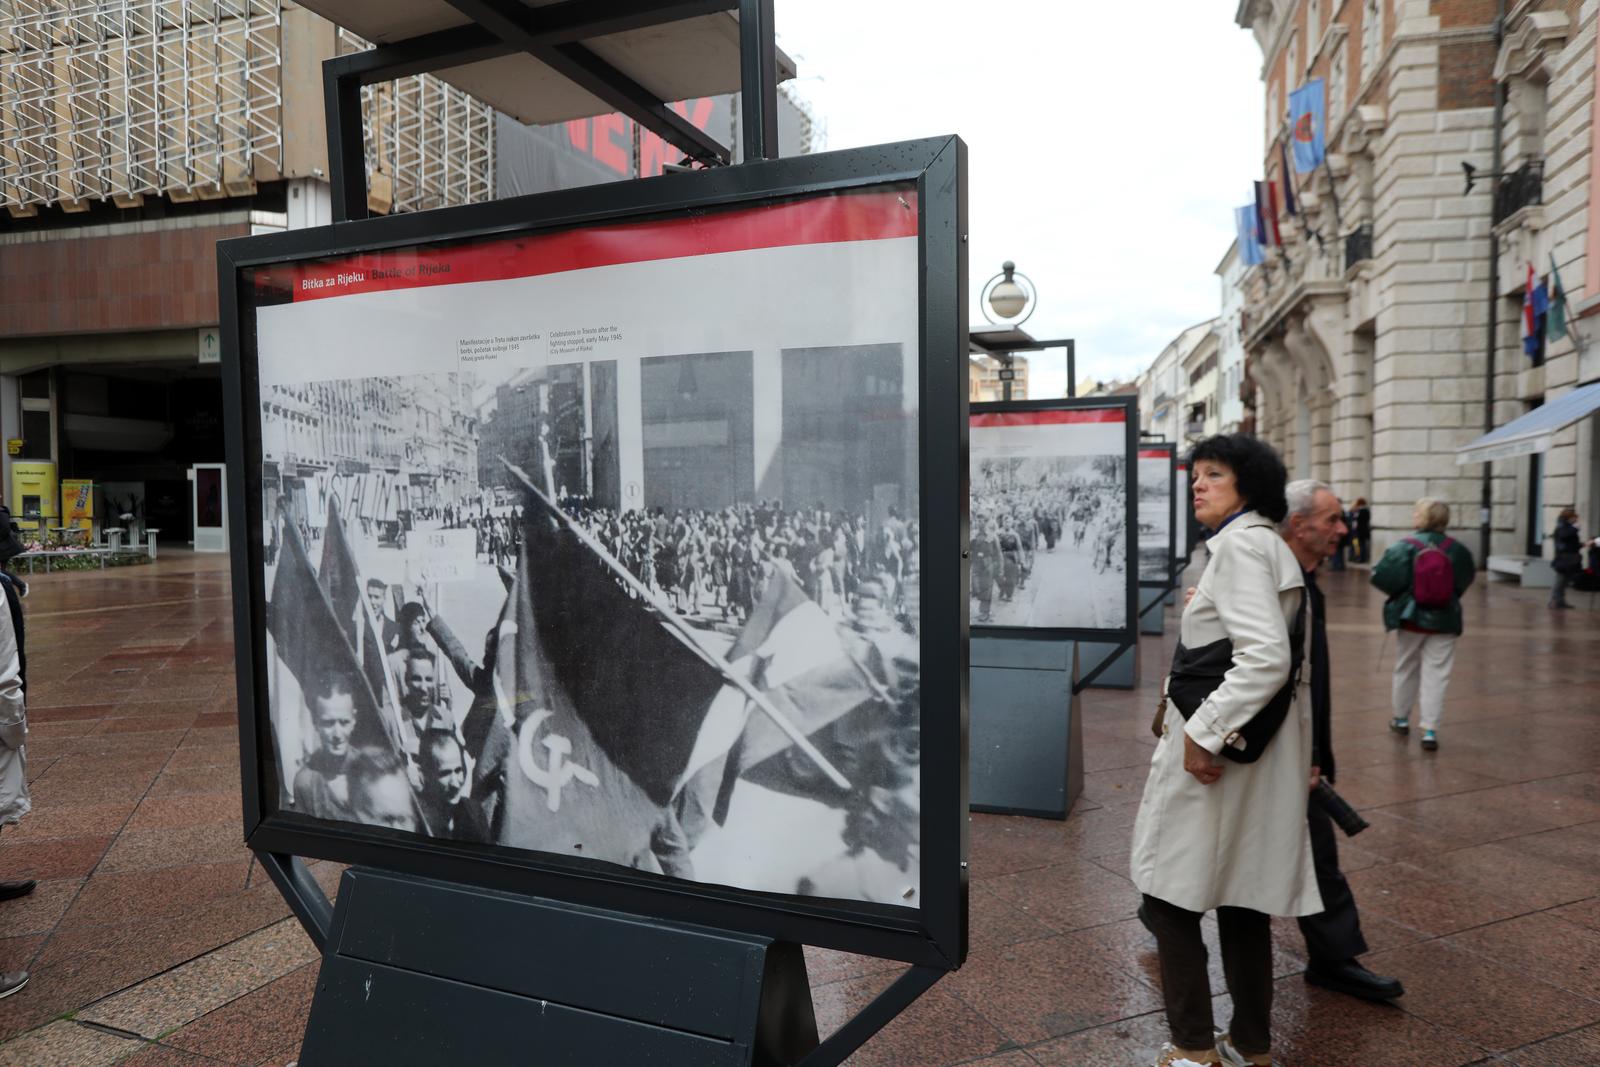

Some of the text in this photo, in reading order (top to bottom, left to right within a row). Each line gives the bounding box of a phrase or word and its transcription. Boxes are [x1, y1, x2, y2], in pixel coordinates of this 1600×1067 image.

[302, 264, 451, 290] Bitka za Rijeku Battle of Rijeka
[598, 335, 609, 343] May
